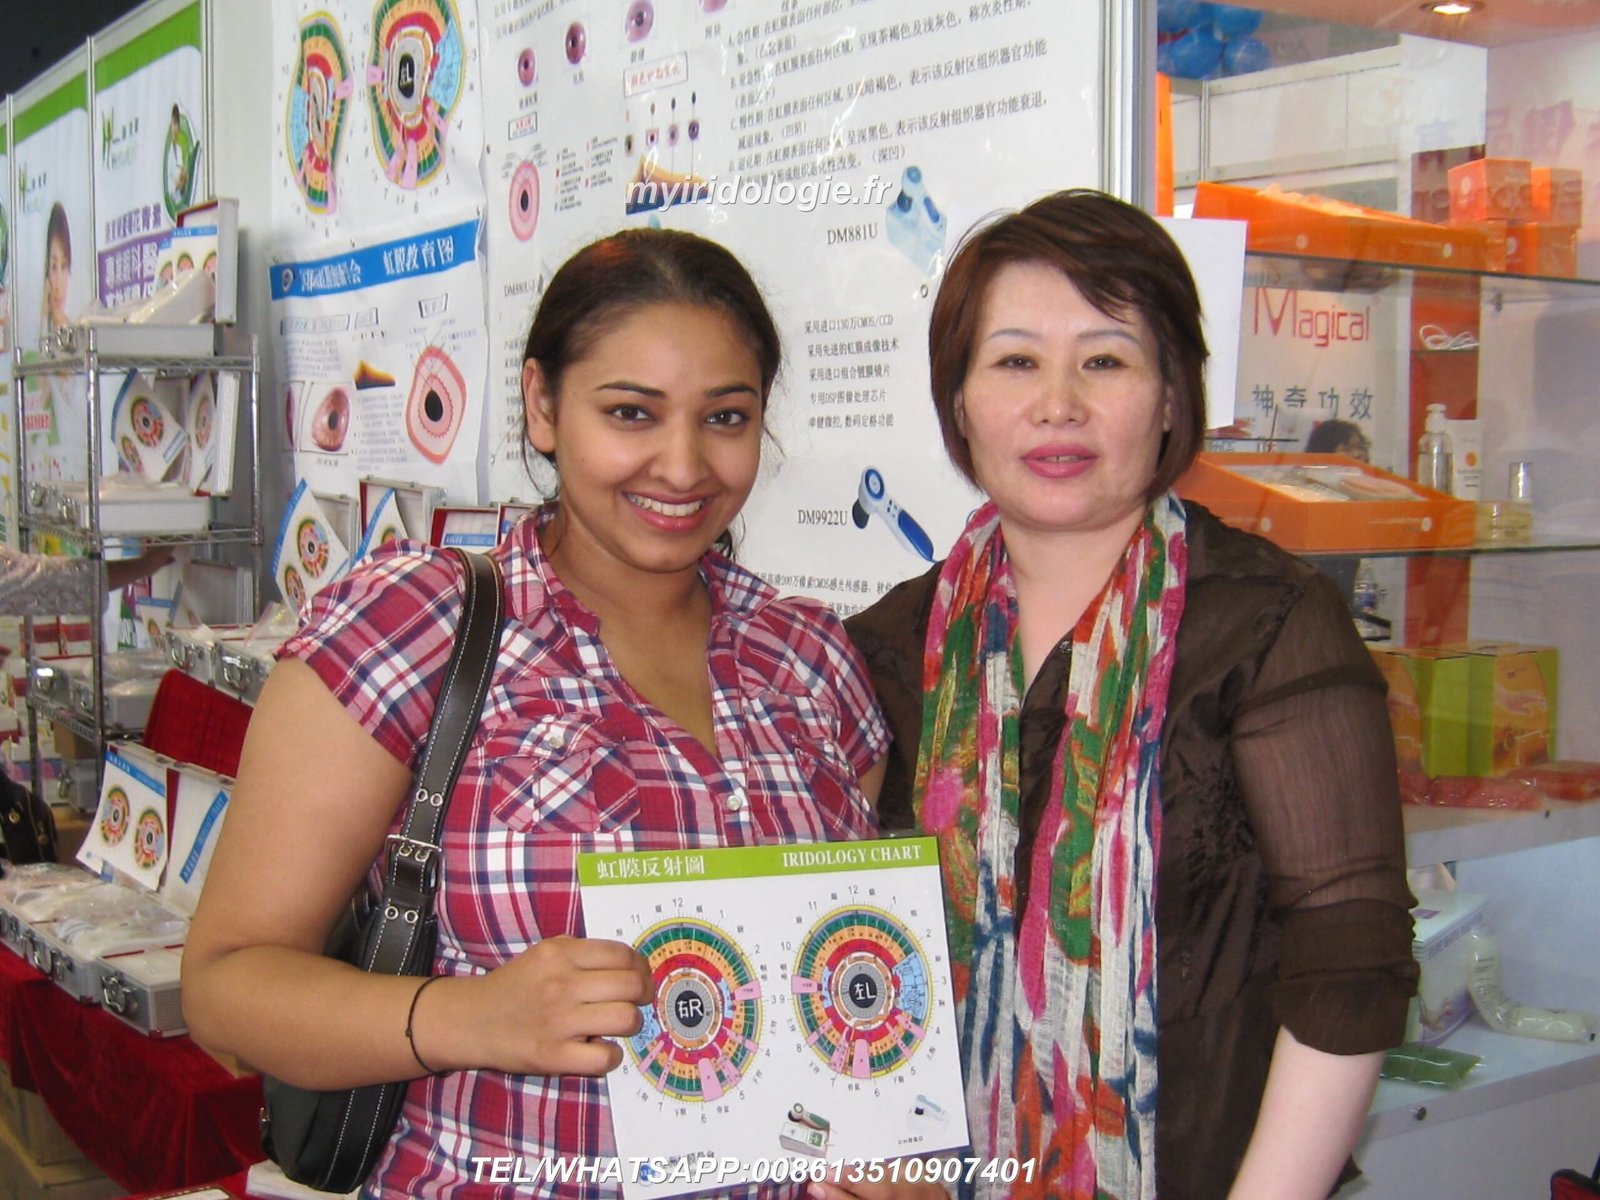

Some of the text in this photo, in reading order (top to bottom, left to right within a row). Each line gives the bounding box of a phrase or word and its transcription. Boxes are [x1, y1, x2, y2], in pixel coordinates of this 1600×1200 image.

[827, 222, 879, 245] DM881U
[1253, 286, 1370, 348] Magical
[1252, 383, 1374, 421] 神奇功效
[798, 508, 849, 526] DM9922U
[782, 844, 923, 868] IRIDOLOGY CHART
[596, 854, 706, 880] 虹膜反射圖
[848, 885, 858, 895] 12
[673, 897, 683, 908] 12
[808, 901, 818, 911] 11
[630, 914, 641, 924] 11
[926, 928, 932, 938] 2
[755, 944, 761, 954] 2
[781, 941, 792, 951] 10
[771, 994, 777, 1005] 3
[779, 994, 785, 1005] 9
[796, 1043, 802, 1053] 8
[623, 1064, 629, 1075] 8
[910, 1066, 916, 1076] 5
[831, 1078, 836, 1088] 7
[740, 1090, 745, 1101] 5
[874, 1087, 880, 1098] 6
[658, 1102, 664, 1112] 7
[701, 1113, 708, 1124] 6
